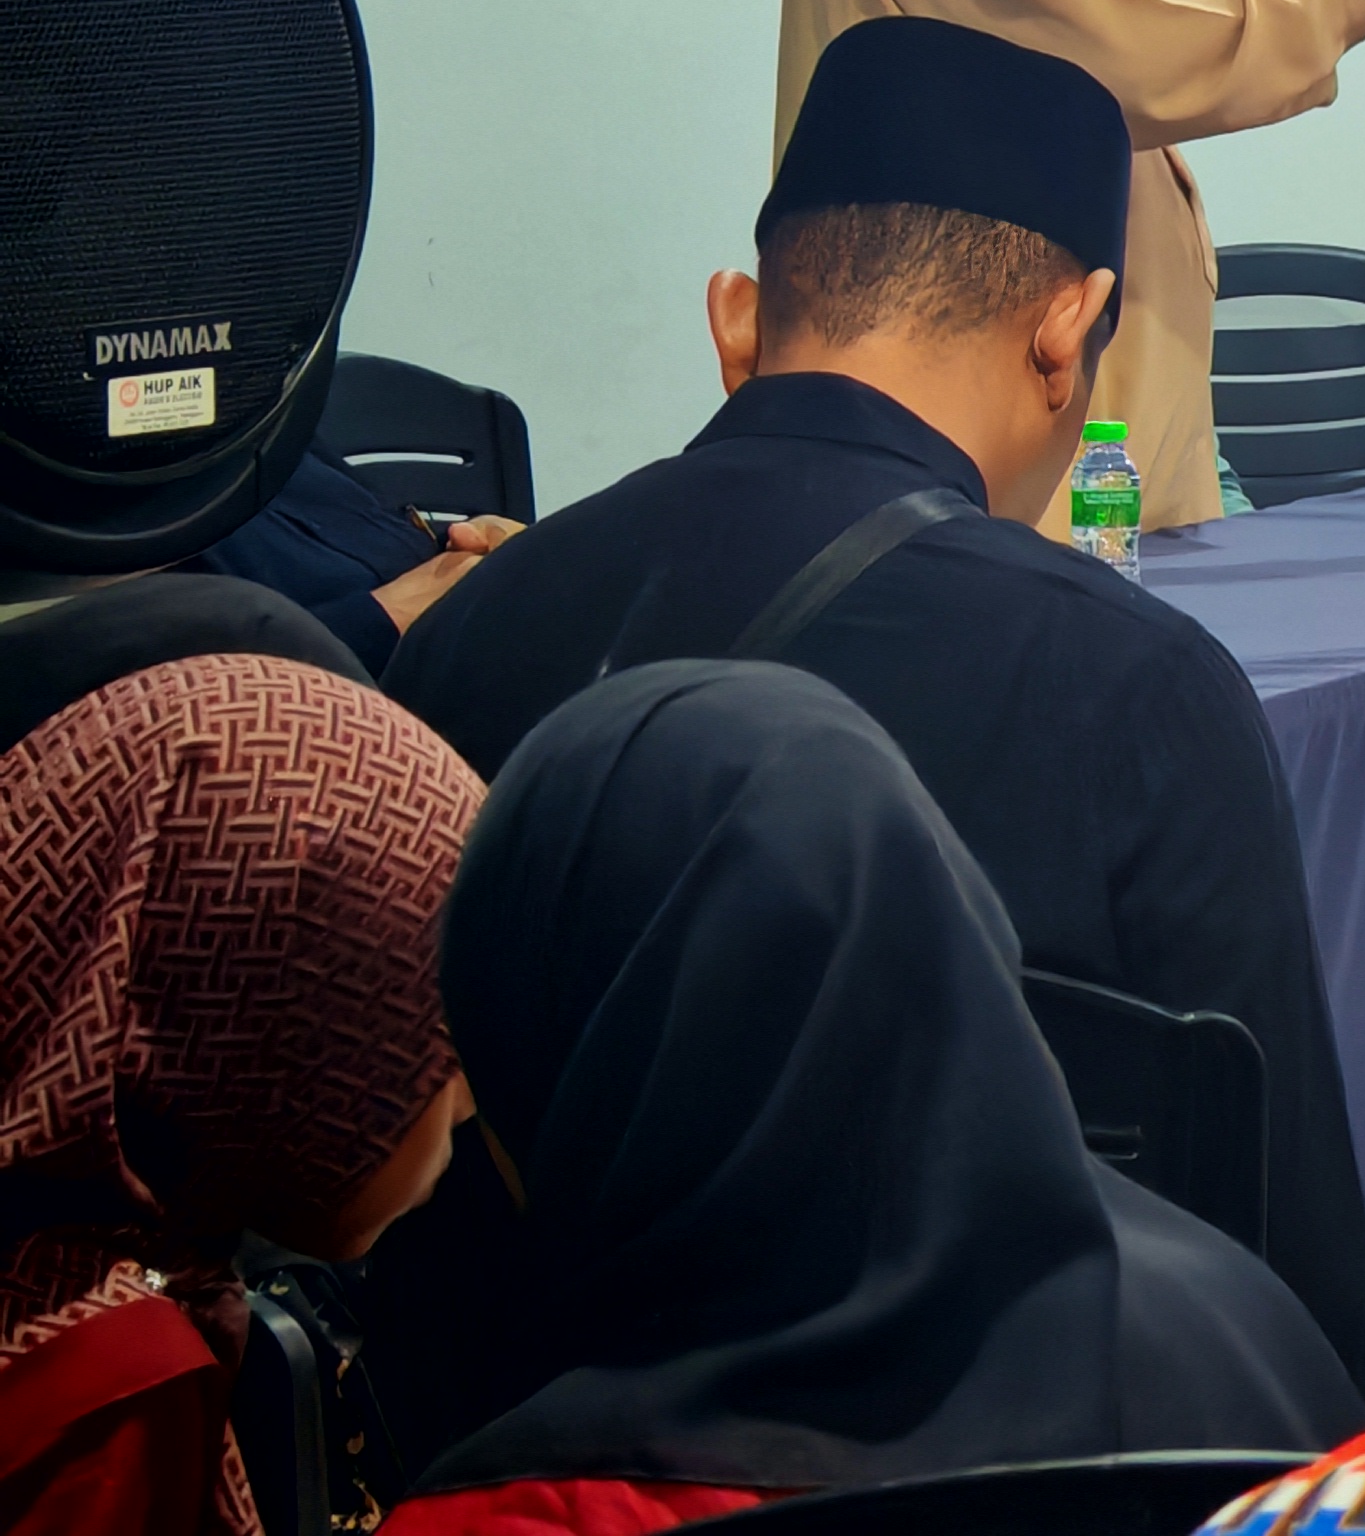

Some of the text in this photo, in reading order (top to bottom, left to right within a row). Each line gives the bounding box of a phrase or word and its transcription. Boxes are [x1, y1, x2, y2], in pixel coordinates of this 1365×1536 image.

[95, 321, 232, 365] DYNAMAX
[143, 375, 203, 395] HUP AIK
